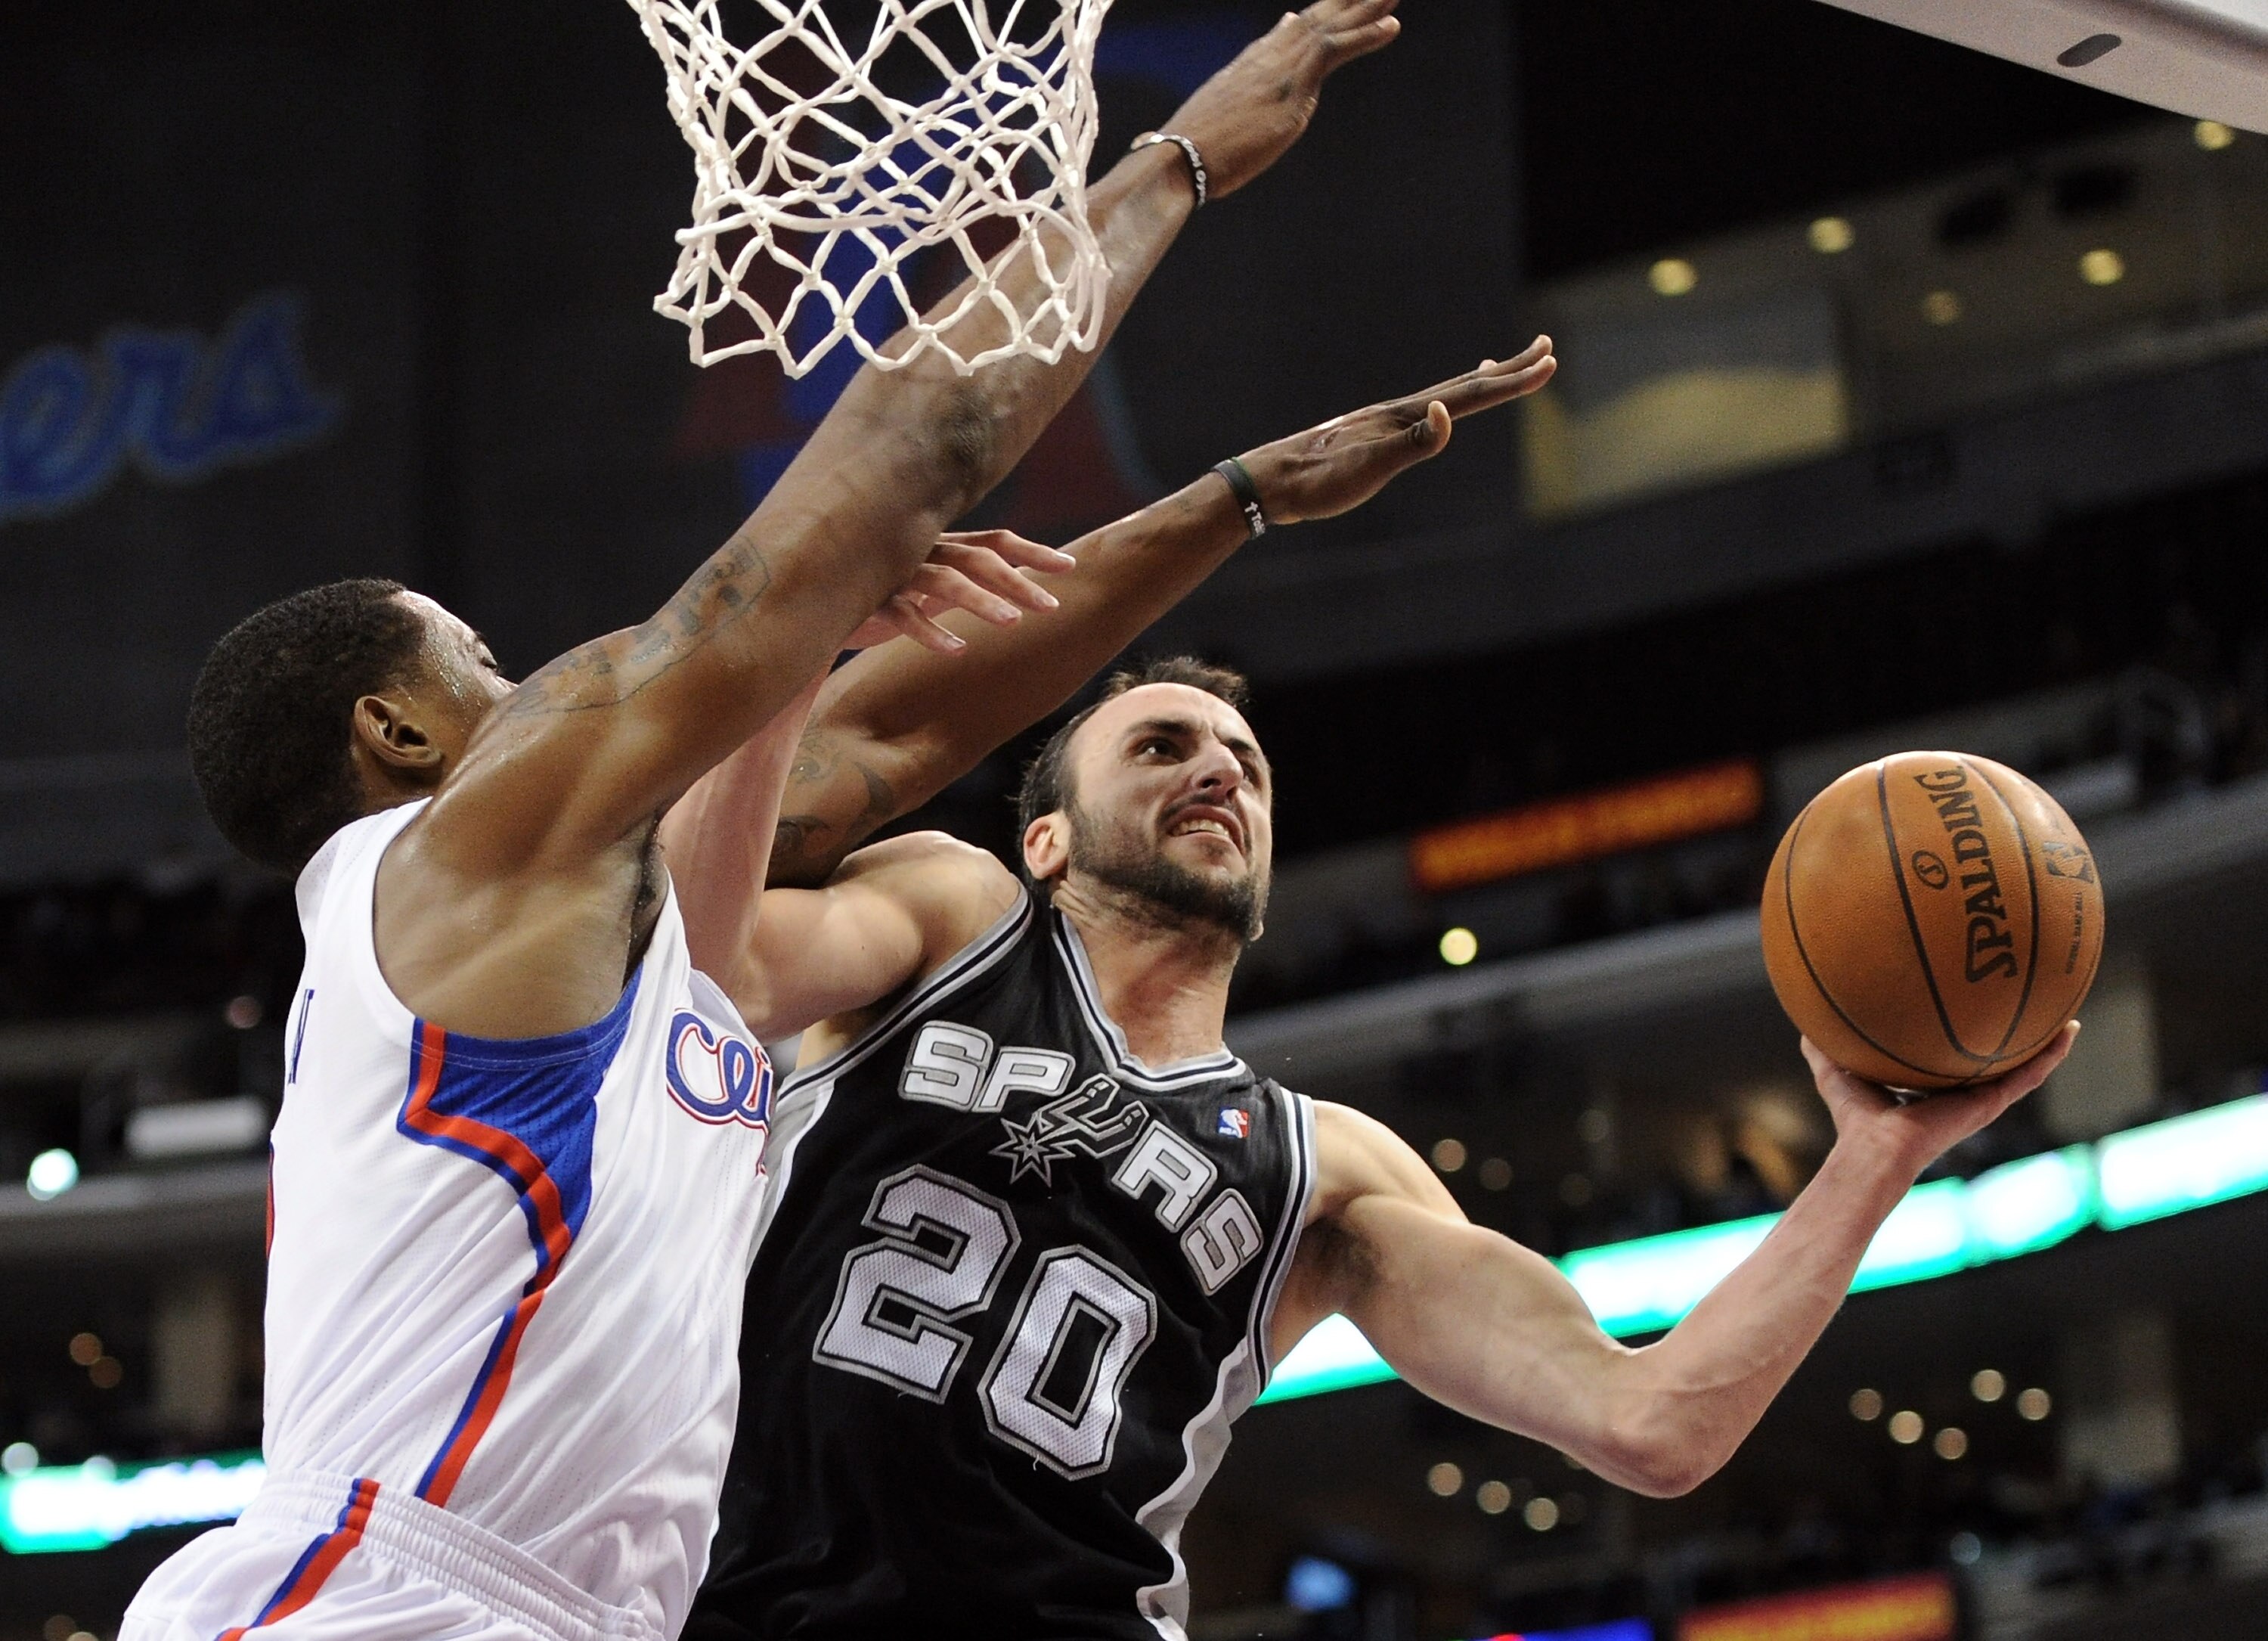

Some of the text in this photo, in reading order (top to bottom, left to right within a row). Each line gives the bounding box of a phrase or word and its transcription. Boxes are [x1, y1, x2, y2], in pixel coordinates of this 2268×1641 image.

[1913, 765, 2017, 983] SPALDING
[898, 1019, 1263, 1295] SPURS
[812, 1163, 1157, 1481] 20
